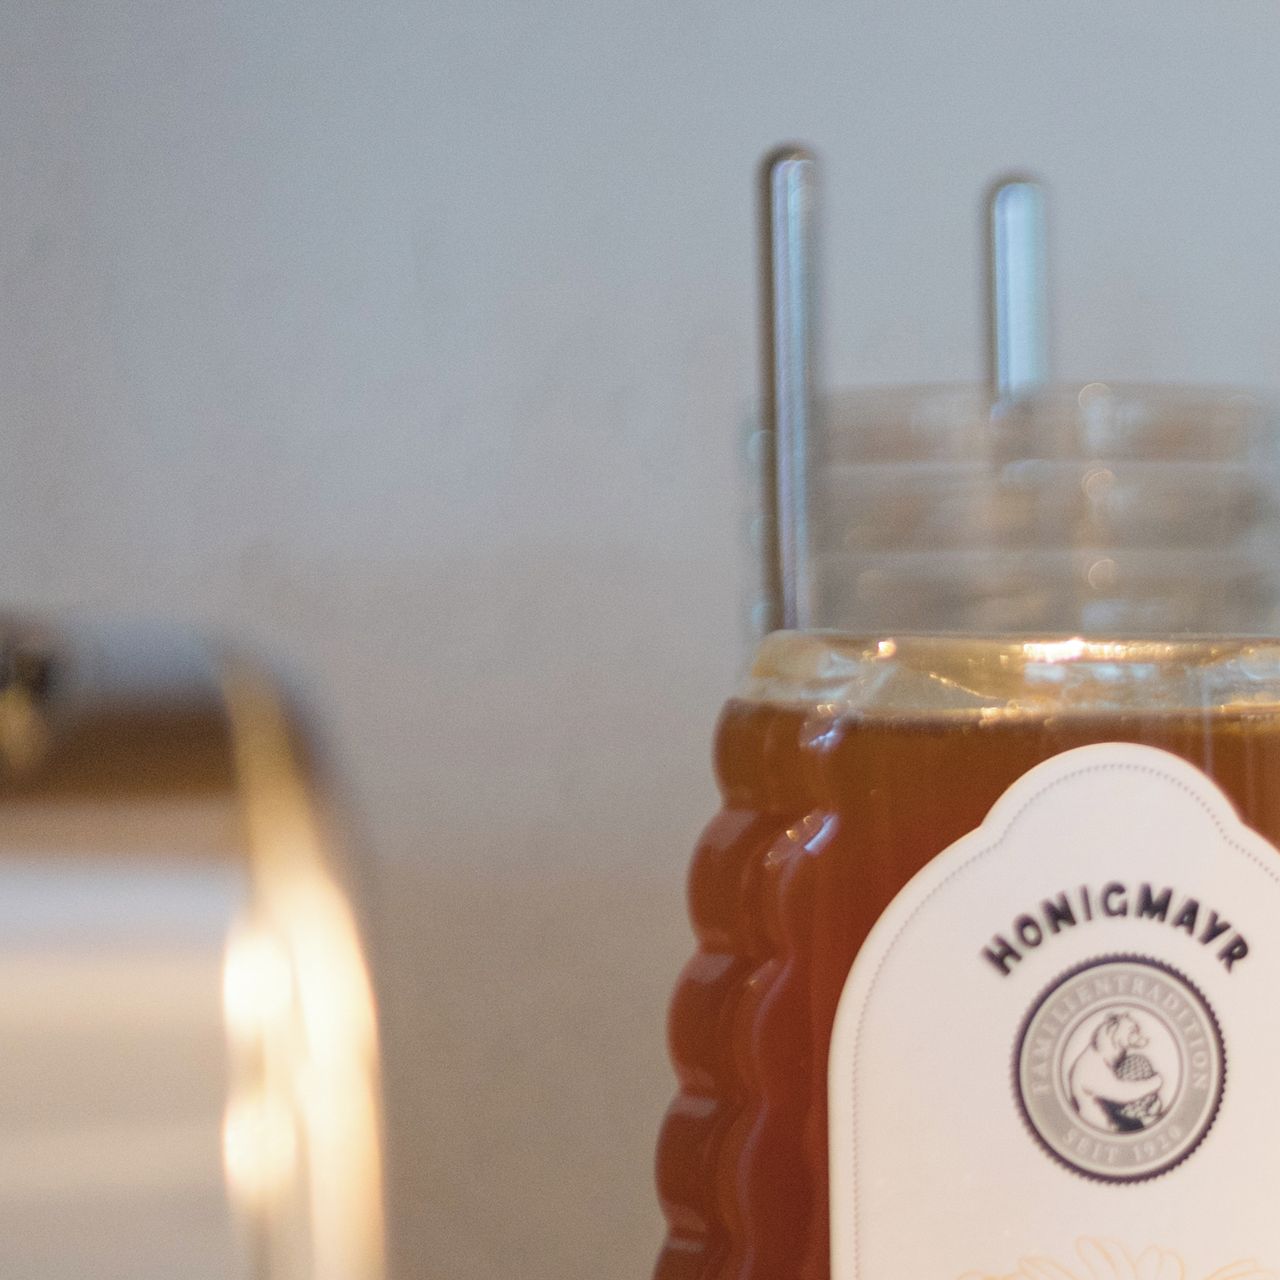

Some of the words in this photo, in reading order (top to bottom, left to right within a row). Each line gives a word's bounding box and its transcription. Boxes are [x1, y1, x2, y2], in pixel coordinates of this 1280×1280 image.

[980, 881, 1251, 977] HONIGMAYR
[1031, 975, 1209, 1095] FAMILIENTRADITION
[1062, 1127, 1120, 1164] SEIT
